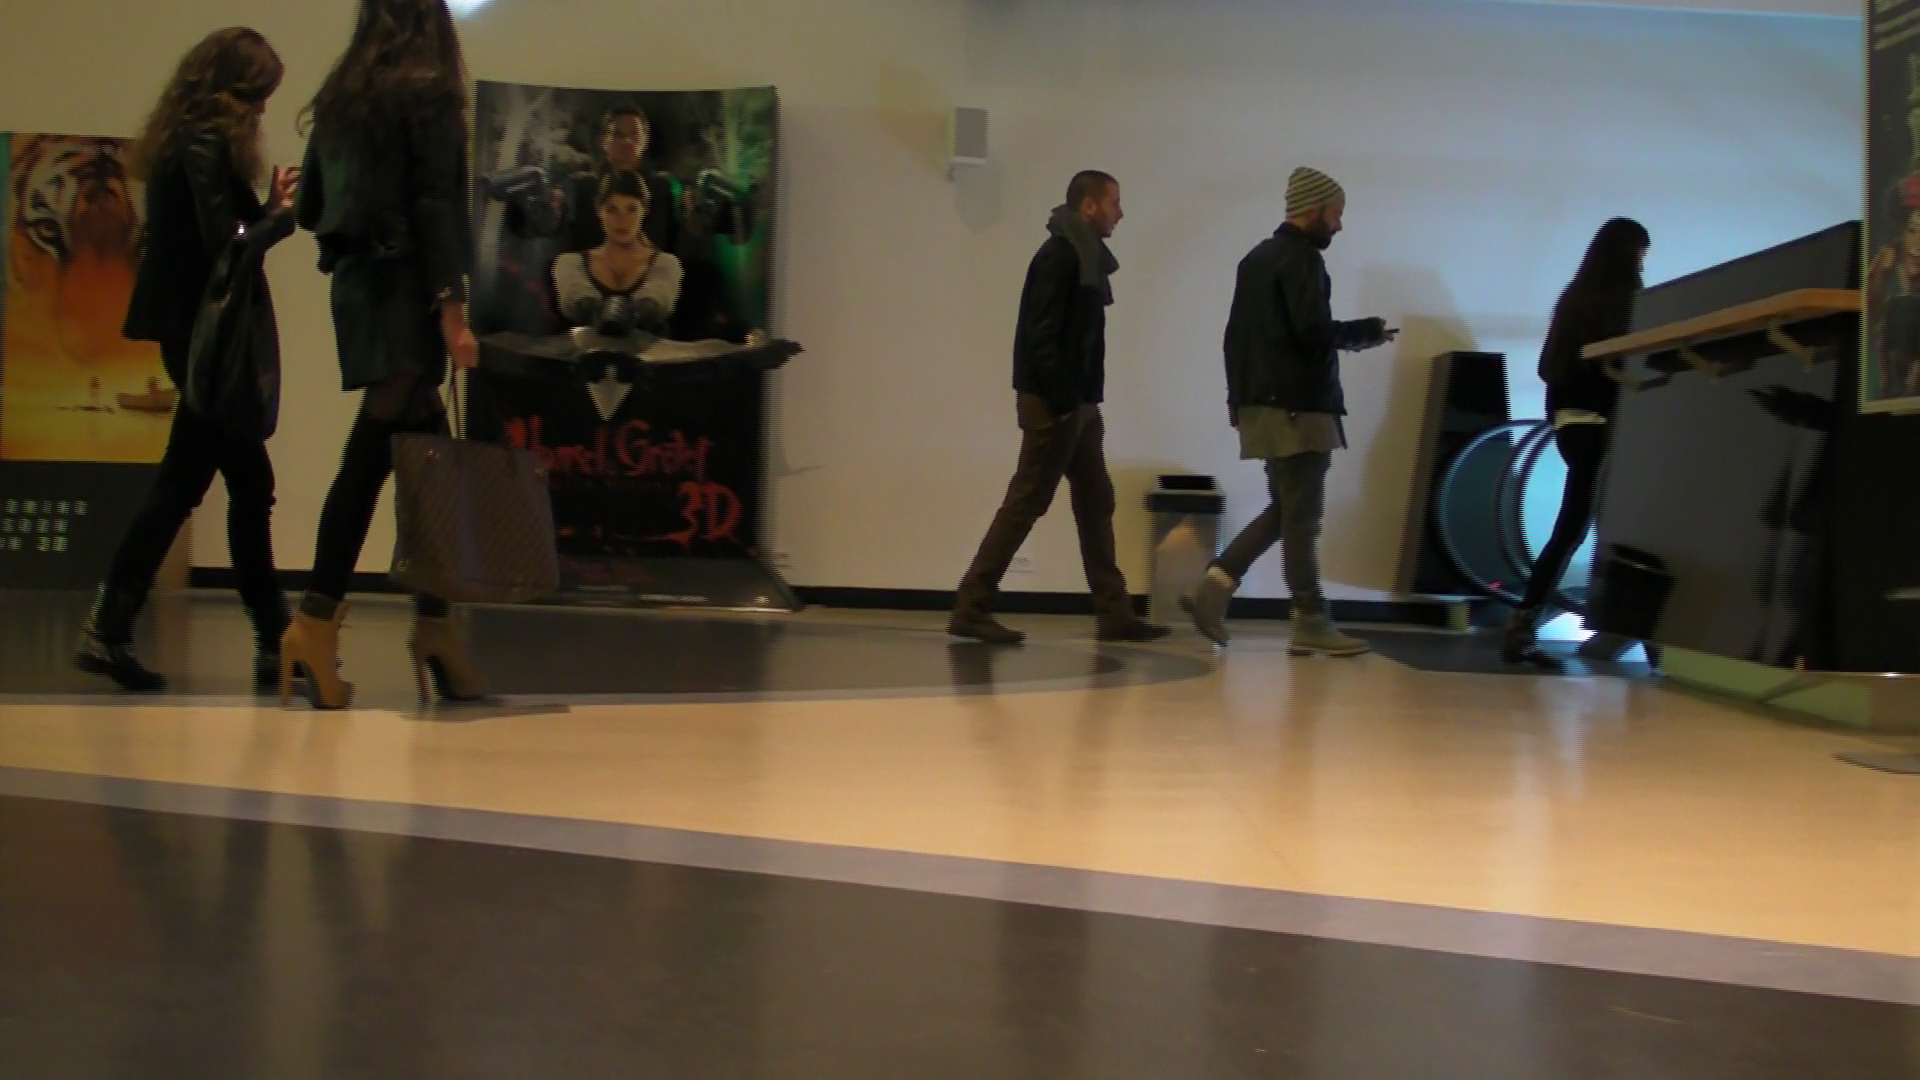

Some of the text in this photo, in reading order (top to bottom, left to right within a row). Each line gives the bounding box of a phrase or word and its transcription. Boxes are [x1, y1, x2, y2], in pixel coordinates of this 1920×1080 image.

[0, 499, 88, 515] OMING
[676, 481, 743, 548] 3D
[2, 518, 69, 533] SOON
[35, 536, 69, 552] 3D
